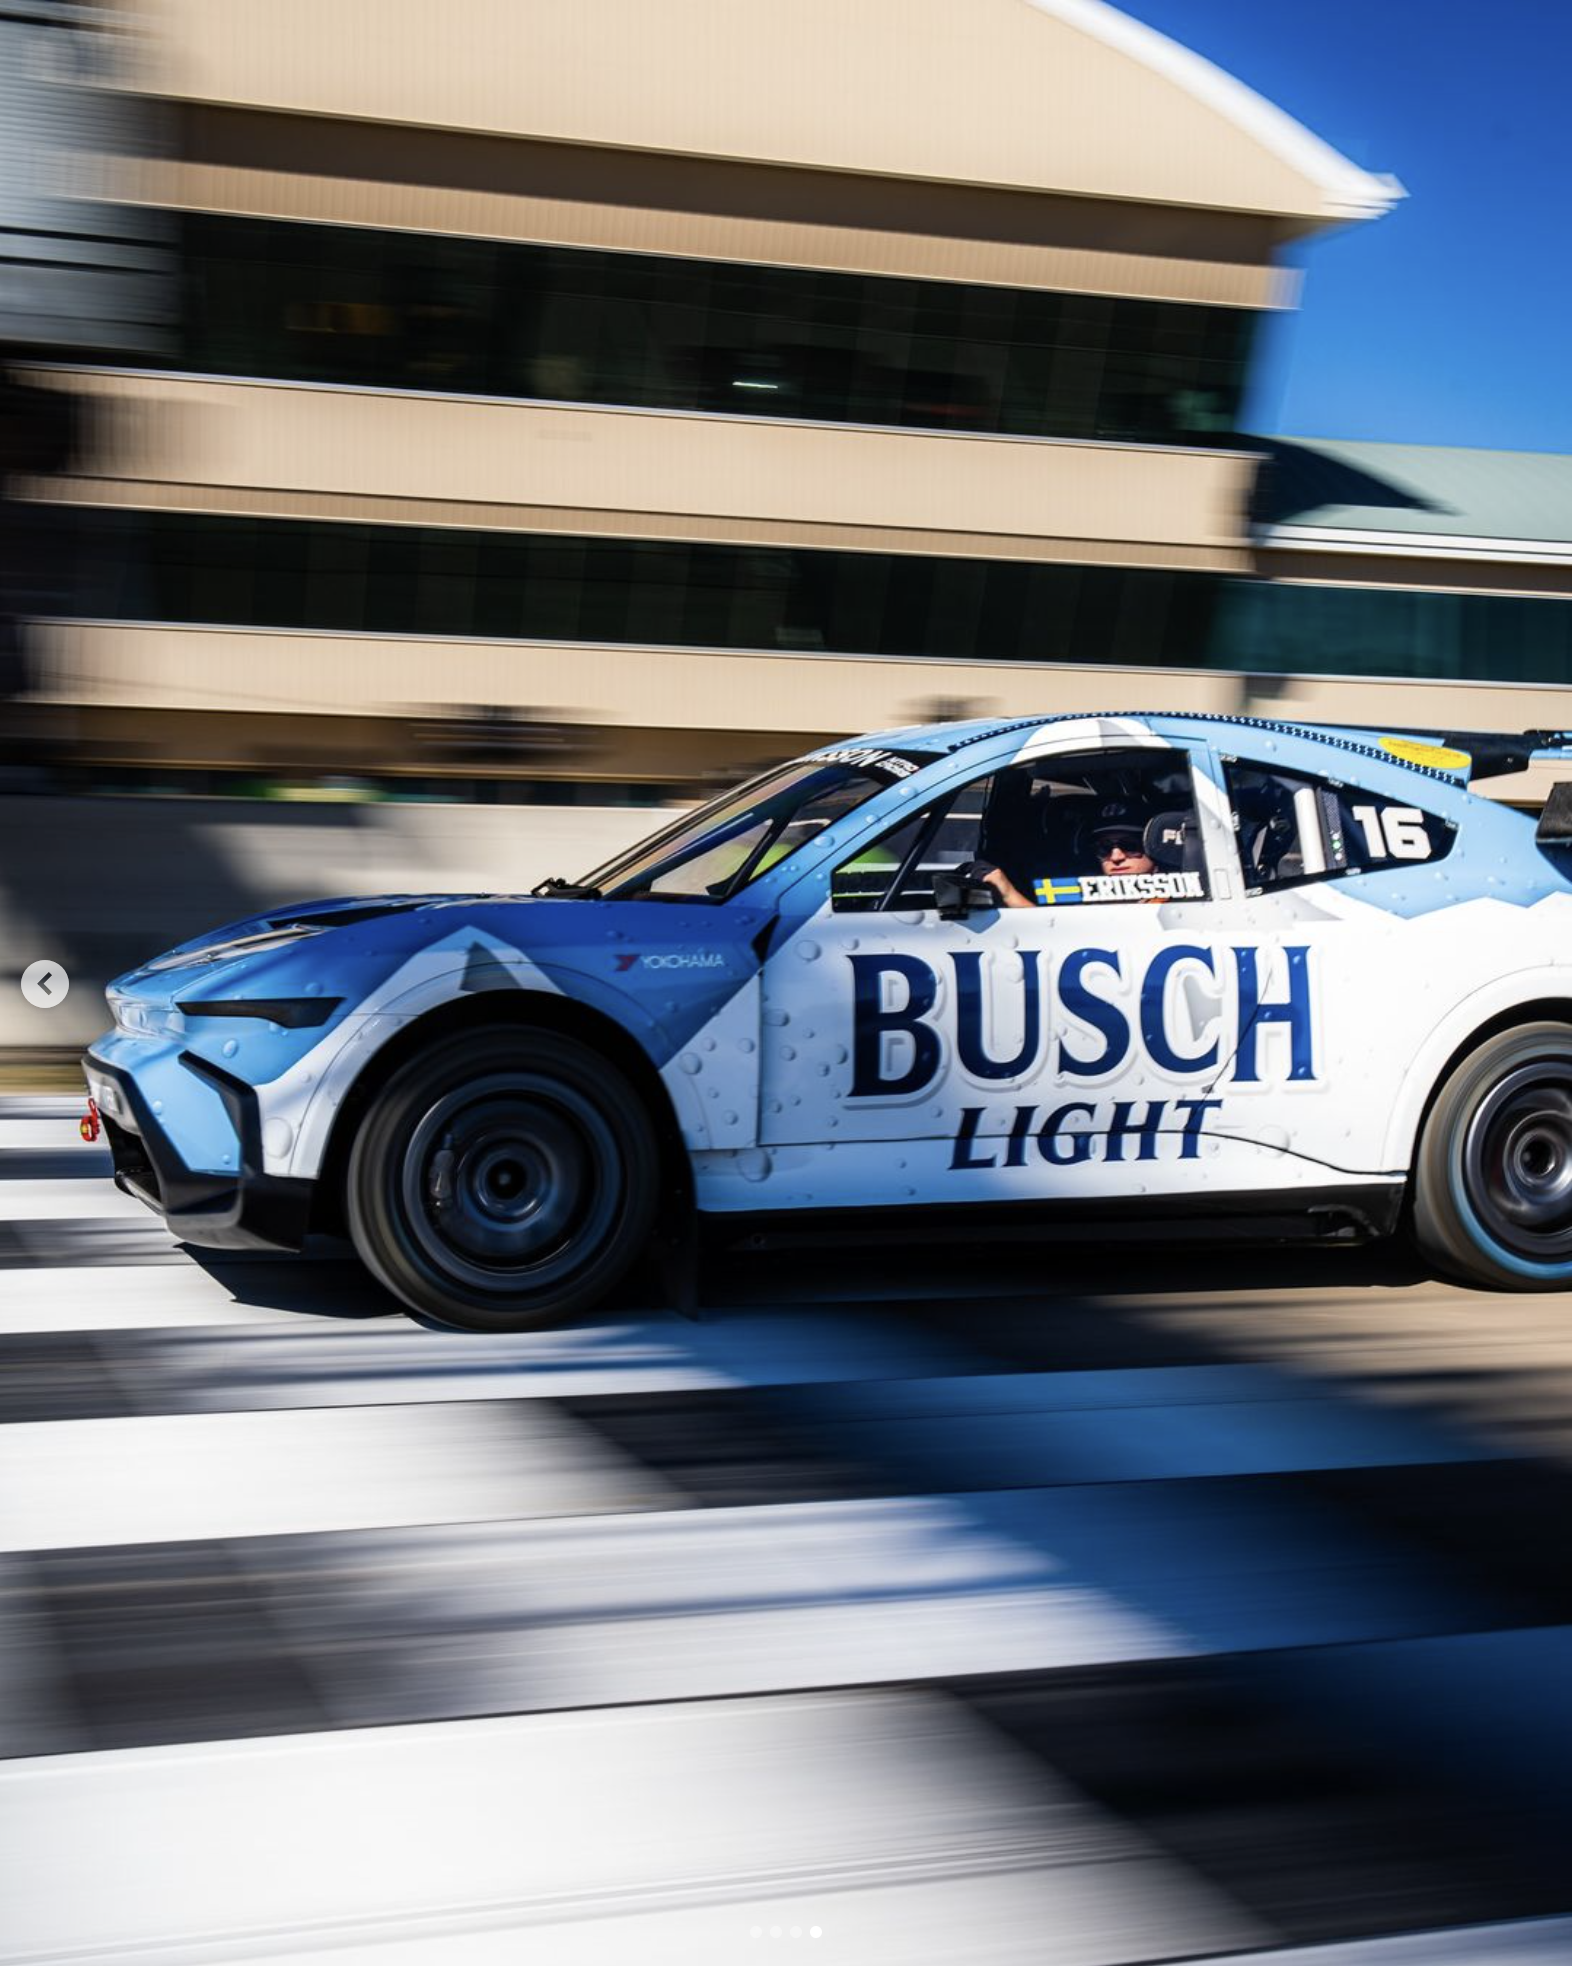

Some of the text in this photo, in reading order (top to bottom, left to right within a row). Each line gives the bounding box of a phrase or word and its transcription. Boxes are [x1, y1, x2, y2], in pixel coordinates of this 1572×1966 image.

[1352, 806, 1432, 859] 16
[1079, 872, 1204, 900] ERIKSSON
[641, 954, 725, 968] YOKOHAMA
[846, 944, 1318, 1098] BUSCH
[947, 1099, 1223, 1170] LIGHT
